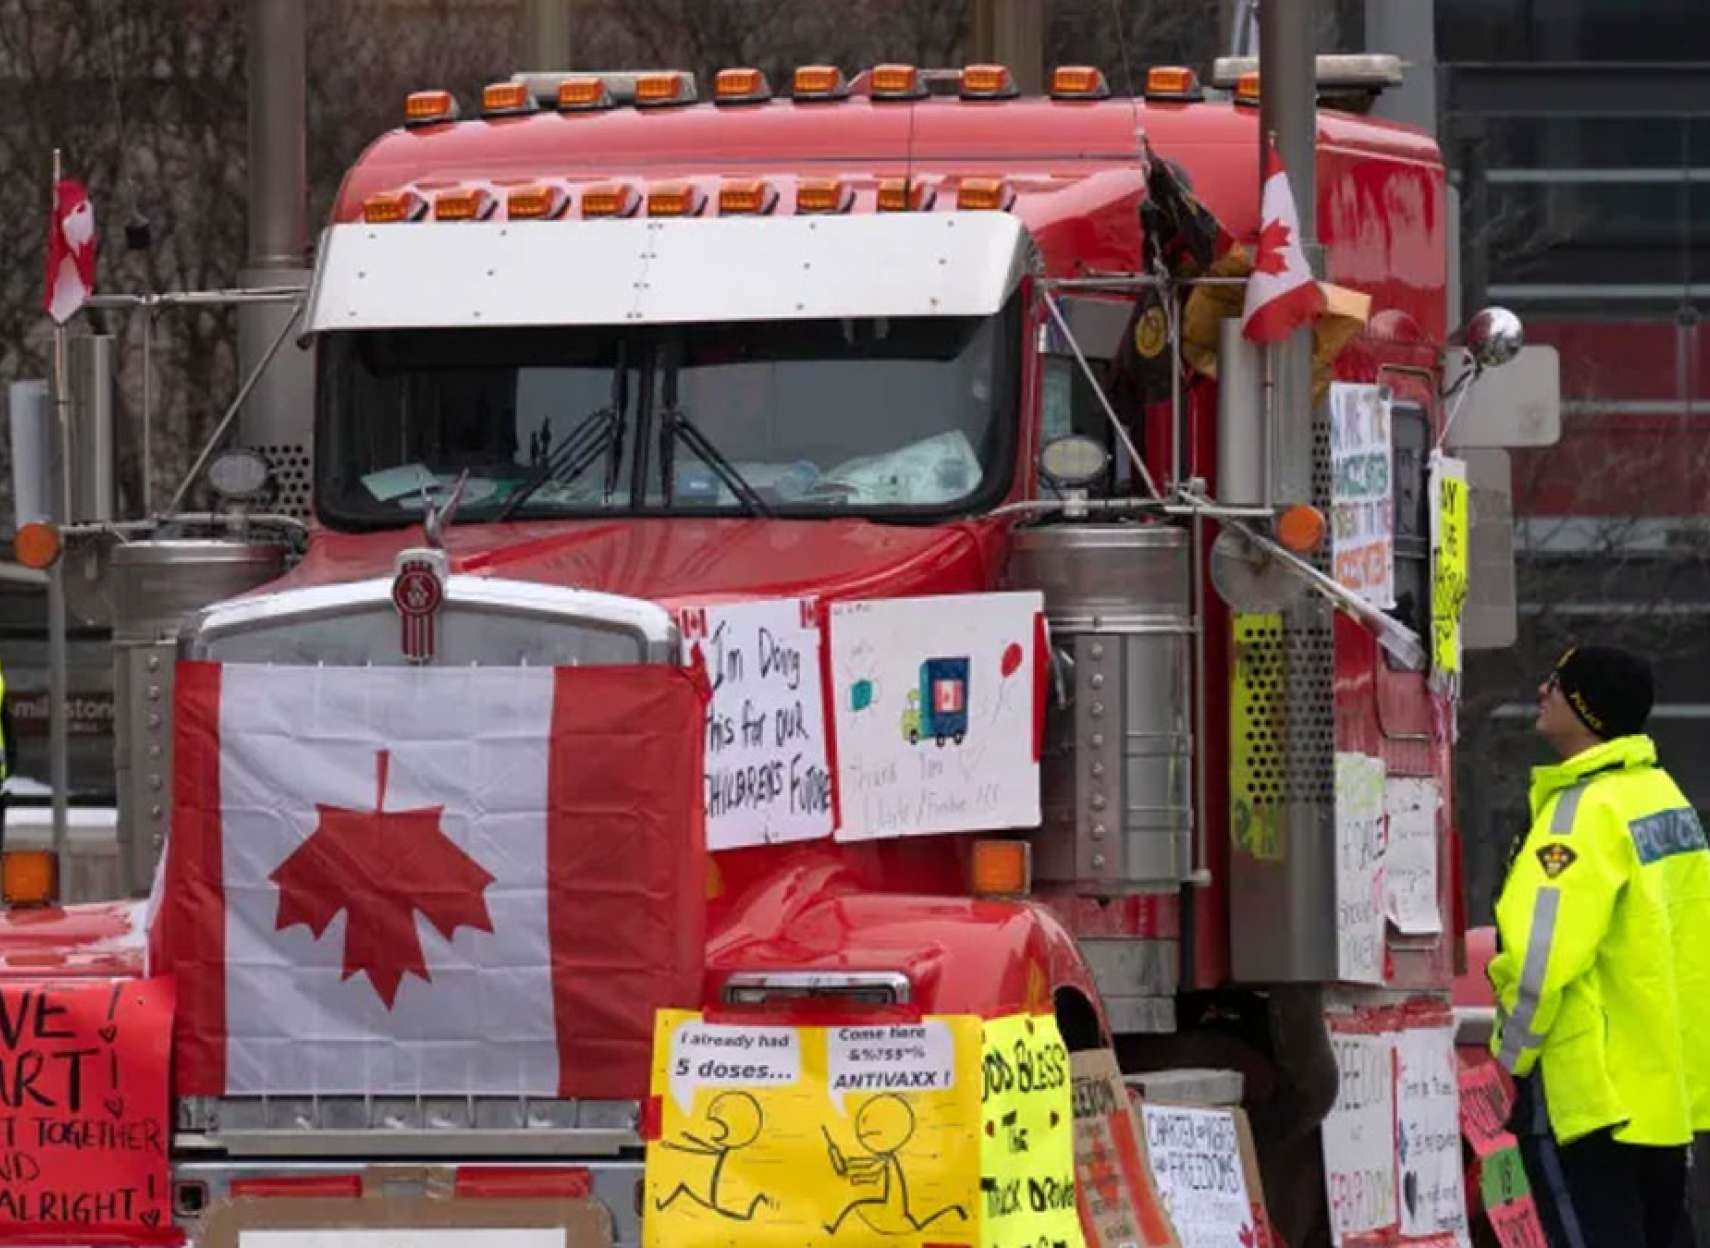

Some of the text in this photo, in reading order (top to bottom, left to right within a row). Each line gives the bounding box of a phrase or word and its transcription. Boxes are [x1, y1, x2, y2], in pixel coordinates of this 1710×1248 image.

[740, 698, 767, 749] for
[774, 699, 811, 748] OUR
[690, 1033, 754, 1050] already
[758, 1033, 790, 1048] had
[838, 1027, 926, 1042] Come here
[675, 1058, 793, 1080] 5 doses...
[833, 1072, 937, 1090] ANTIVAXX
[31, 1116, 163, 1151] TOGETHER
